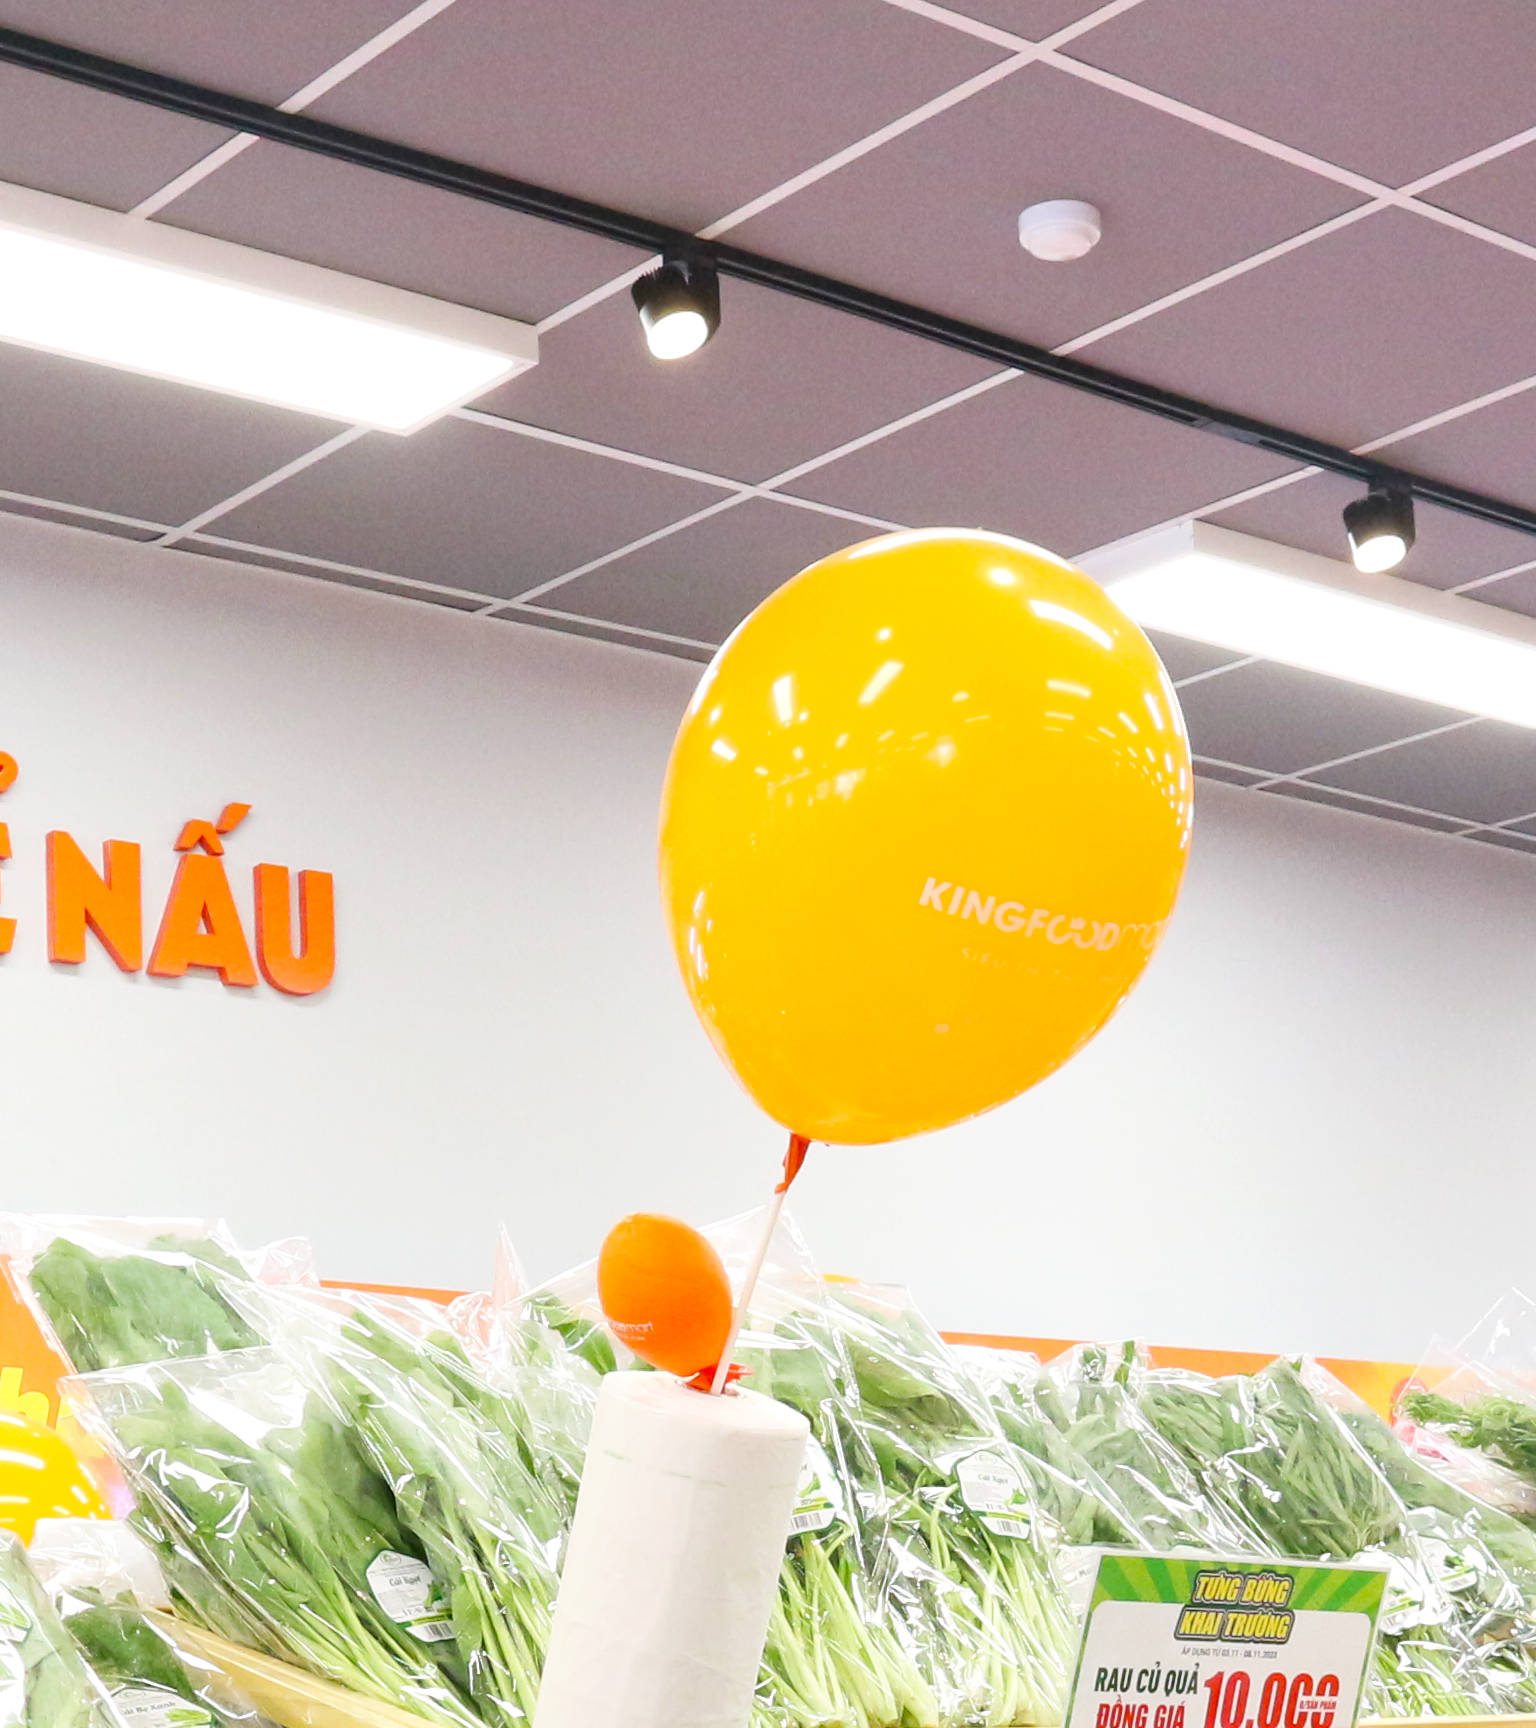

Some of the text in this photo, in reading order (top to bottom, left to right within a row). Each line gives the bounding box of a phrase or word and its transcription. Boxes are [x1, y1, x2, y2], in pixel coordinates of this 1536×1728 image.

[45, 801, 336, 997] NẤU
[1179, 1611, 1291, 1639] KHAI TRƯƠNG
[1094, 1667, 1132, 1693] RAU
[1136, 1661, 1161, 1694] CỦ
[1164, 1662, 1200, 1696] QUẢ
